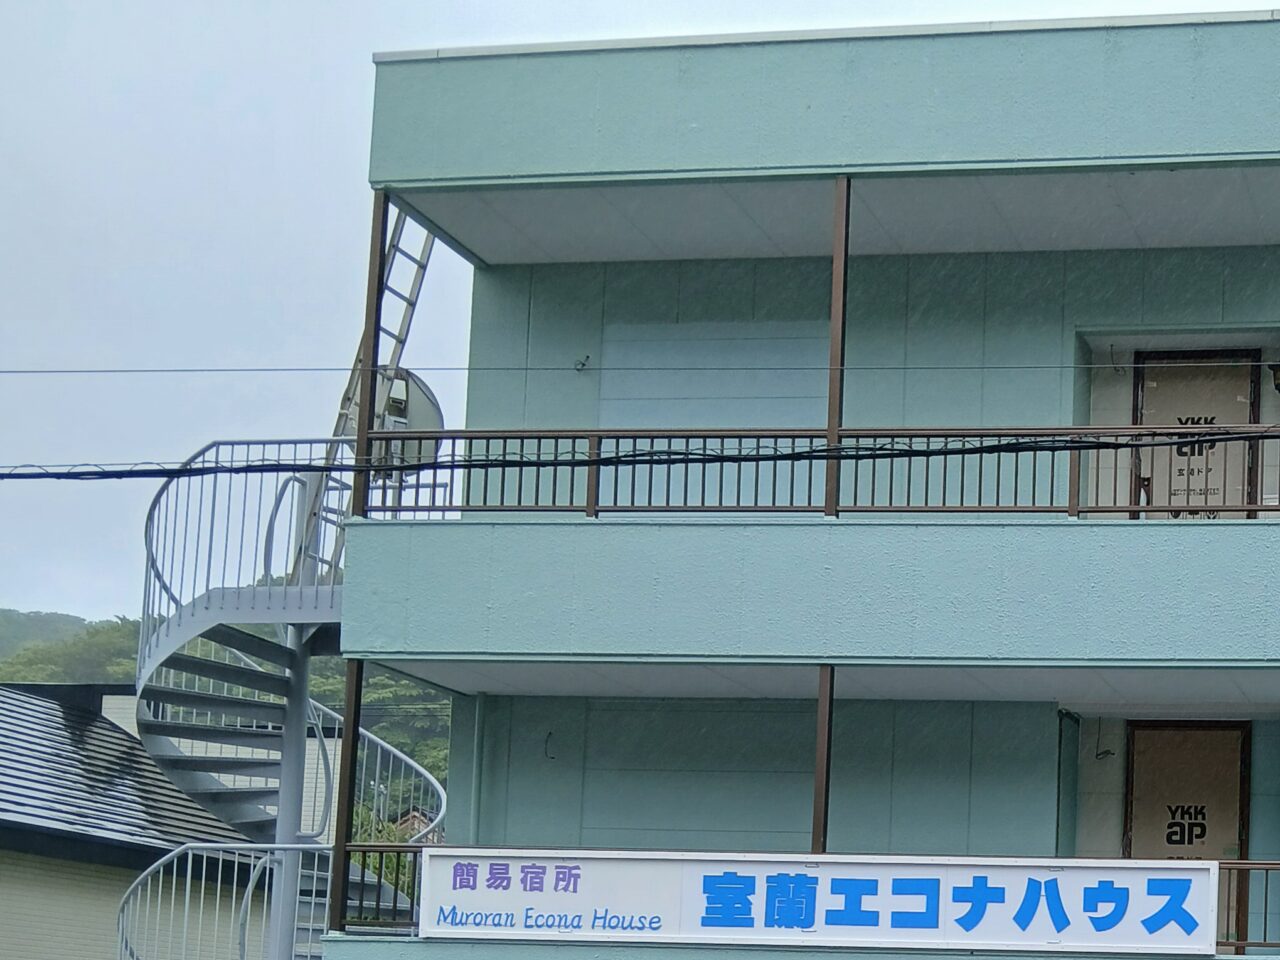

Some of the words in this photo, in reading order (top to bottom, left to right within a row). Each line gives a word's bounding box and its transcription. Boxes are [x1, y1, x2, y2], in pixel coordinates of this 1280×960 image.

[1166, 805, 1207, 821] YKK
[1166, 822, 1207, 845] ap
[452, 861, 582, 894] 簡易宿所
[701, 871, 1200, 936] 室蘭エコナハウス
[437, 904, 517, 928] Muroran
[524, 907, 583, 930] Econa
[591, 908, 663, 931] House
